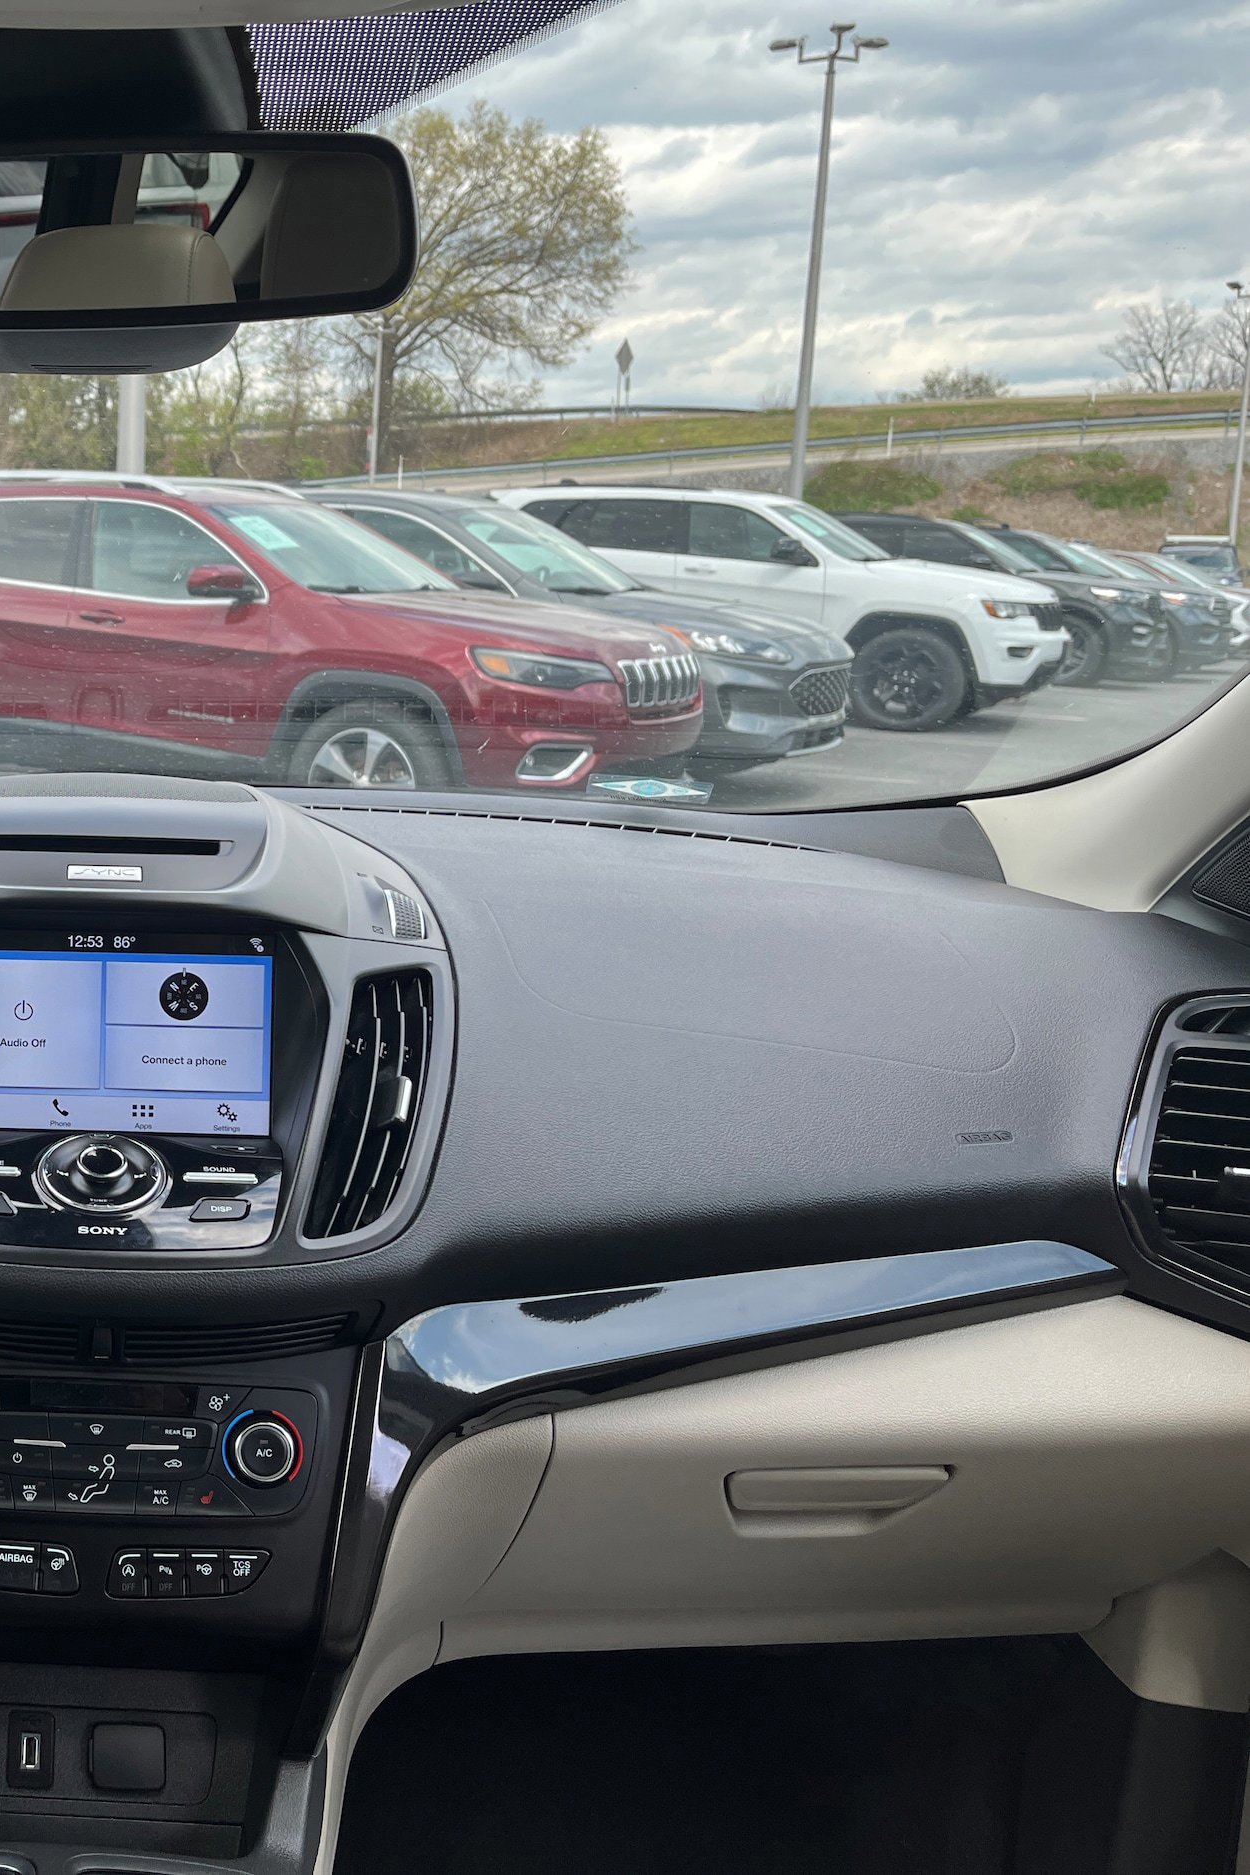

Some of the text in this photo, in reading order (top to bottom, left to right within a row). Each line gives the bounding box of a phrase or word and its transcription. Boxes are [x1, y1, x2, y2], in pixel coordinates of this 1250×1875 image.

[74, 868, 135, 876] SYNC
[68, 935, 136, 949] 12:53 86°
[190, 982, 199, 992] E
[189, 1002, 198, 1011] S
[0, 1038, 46, 1047] Audio Off
[141, 1055, 184, 1065] Connect
[195, 1055, 227, 1068] phone
[134, 1122, 152, 1130] Apps
[213, 1124, 240, 1133] Settings
[210, 1205, 232, 1213] DISP
[77, 1226, 128, 1235] SONY
[256, 1448, 273, 1458] A/C
[152, 1496, 169, 1505] A/C
[122, 1583, 135, 1591] OFF
[159, 1583, 173, 1591] OFF
